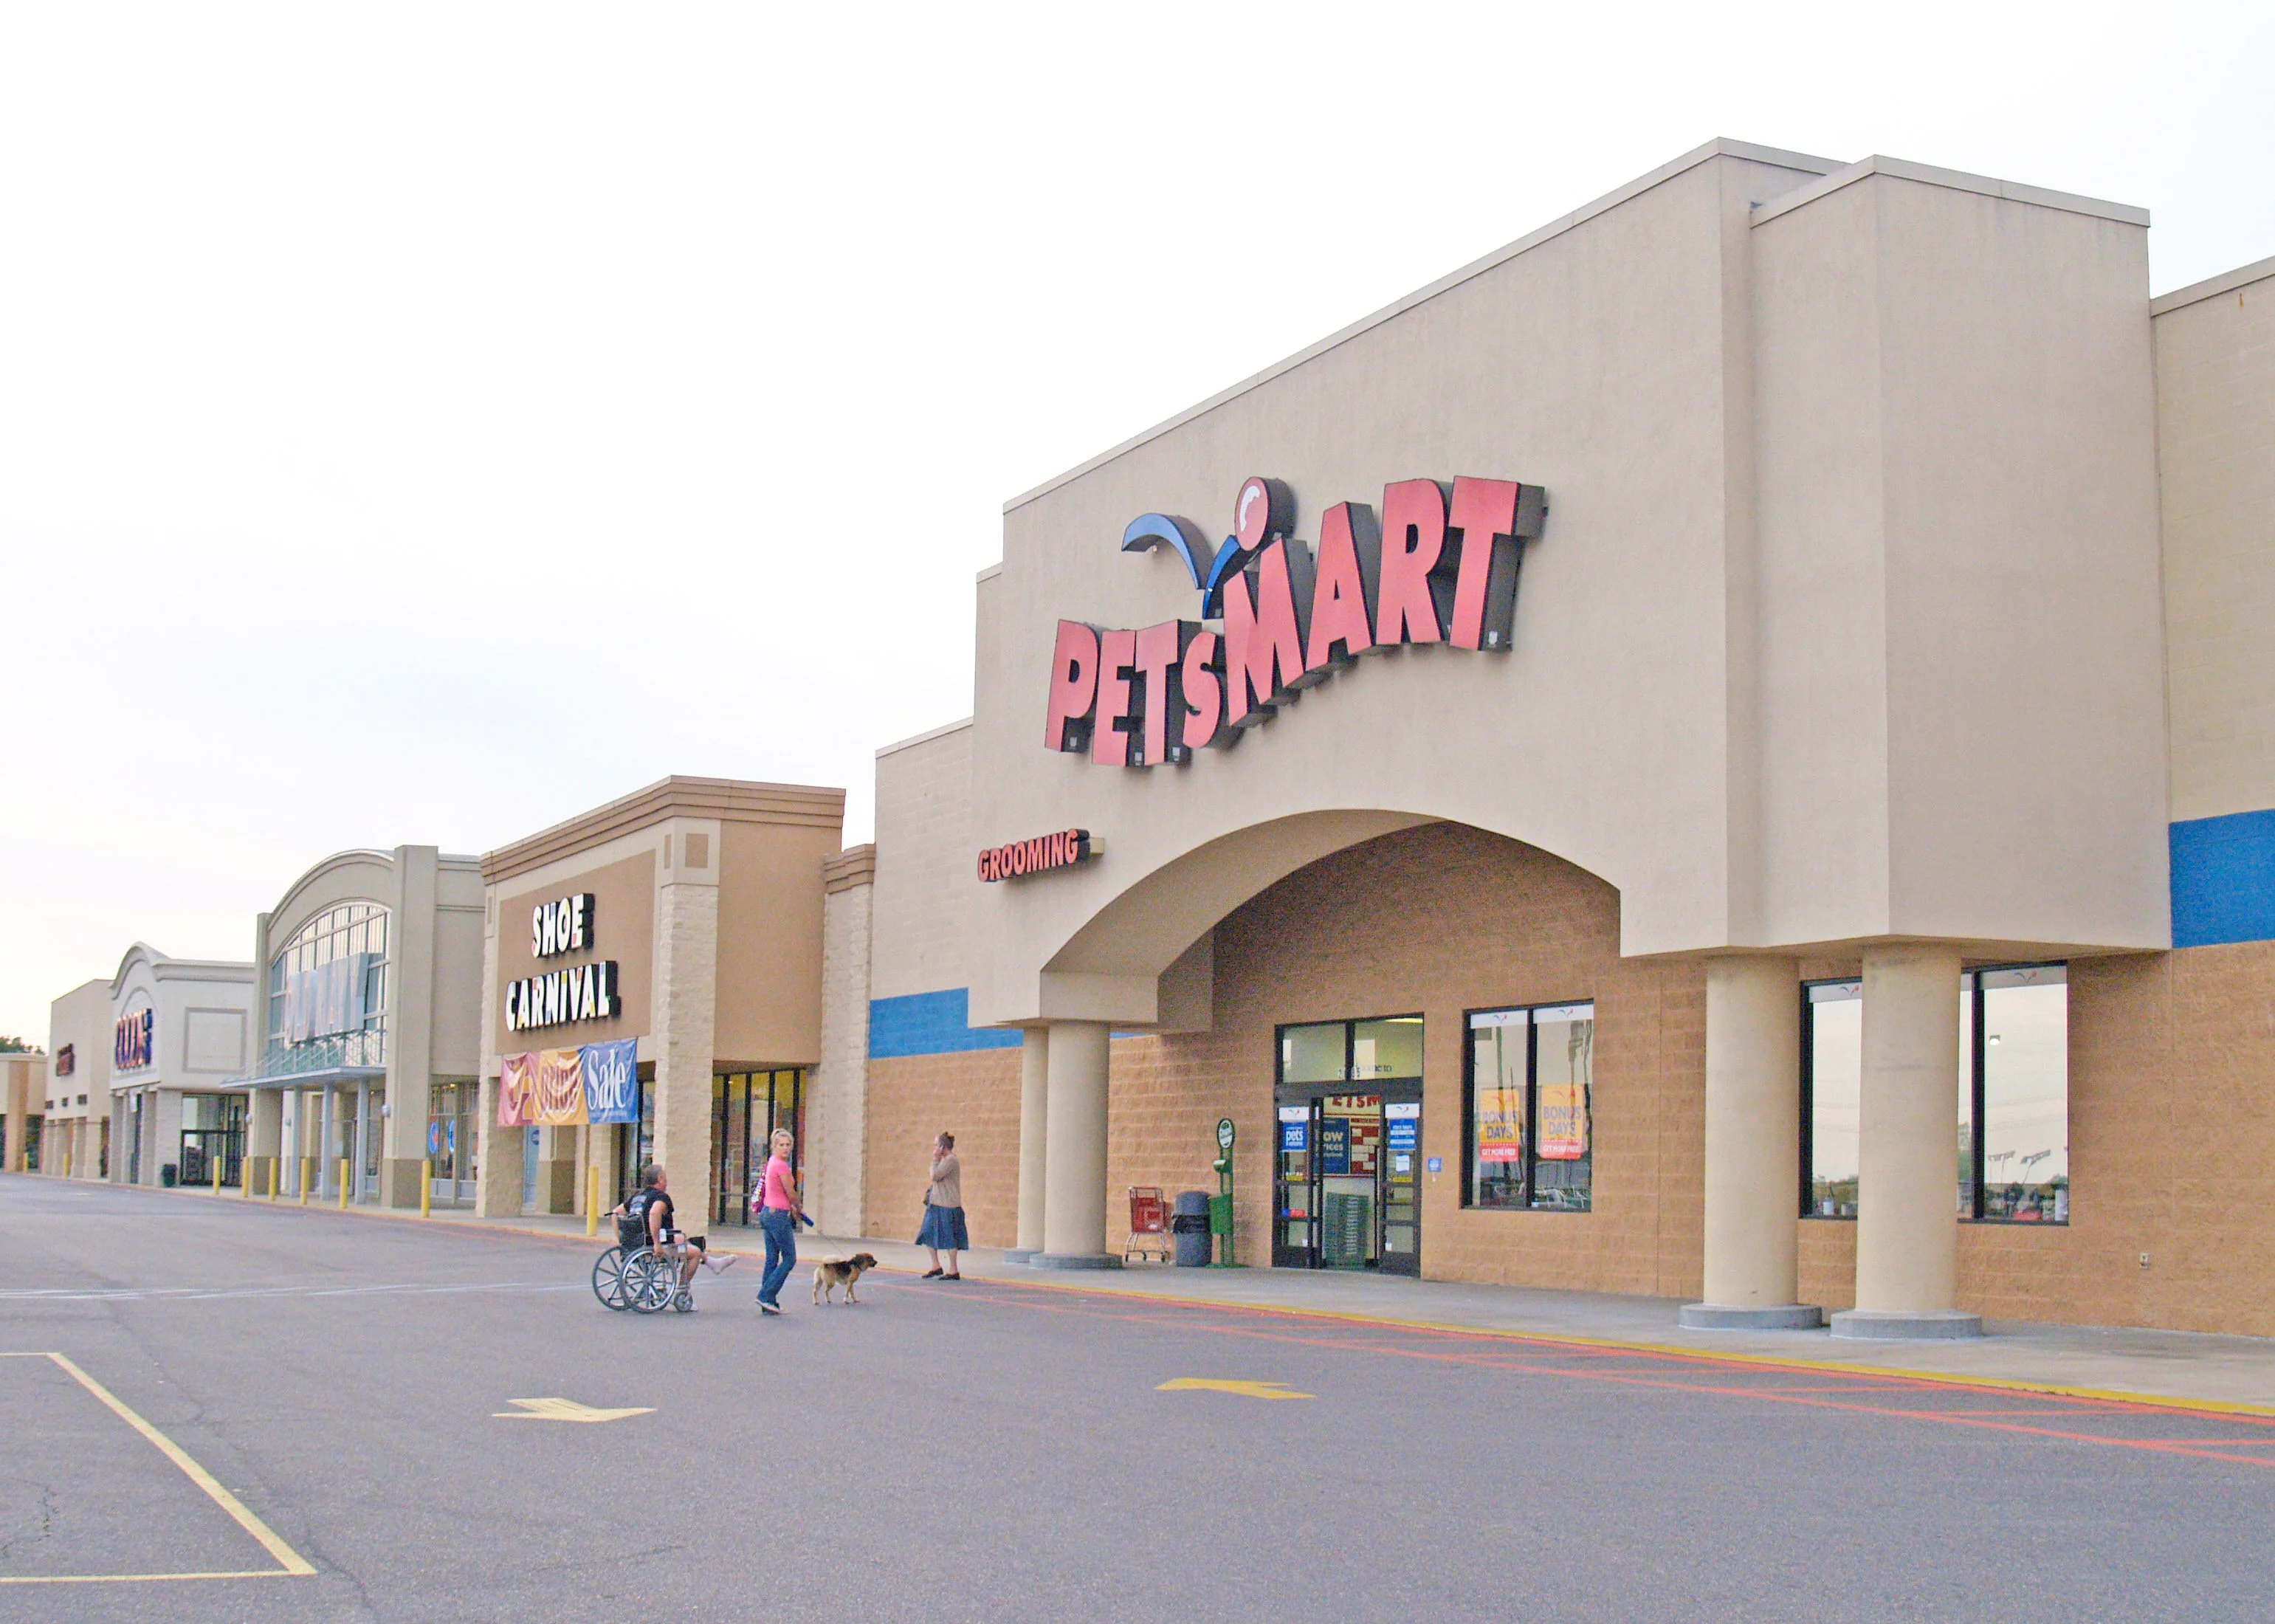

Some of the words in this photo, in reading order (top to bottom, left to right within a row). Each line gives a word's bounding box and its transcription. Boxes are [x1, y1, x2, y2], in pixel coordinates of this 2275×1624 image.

[977, 828, 1080, 883] GROOMING
[531, 892, 588, 959] SHOE
[506, 960, 614, 1033] CARNIVAL
[588, 1047, 627, 1111] Sale
[1482, 1109, 1518, 1124] BONUS
[1543, 1106, 1582, 1119] BONUS
[1487, 1125, 1512, 1139] DAYS
[1549, 1121, 1576, 1135] DAYS
[1323, 1131, 1343, 1142] ow
